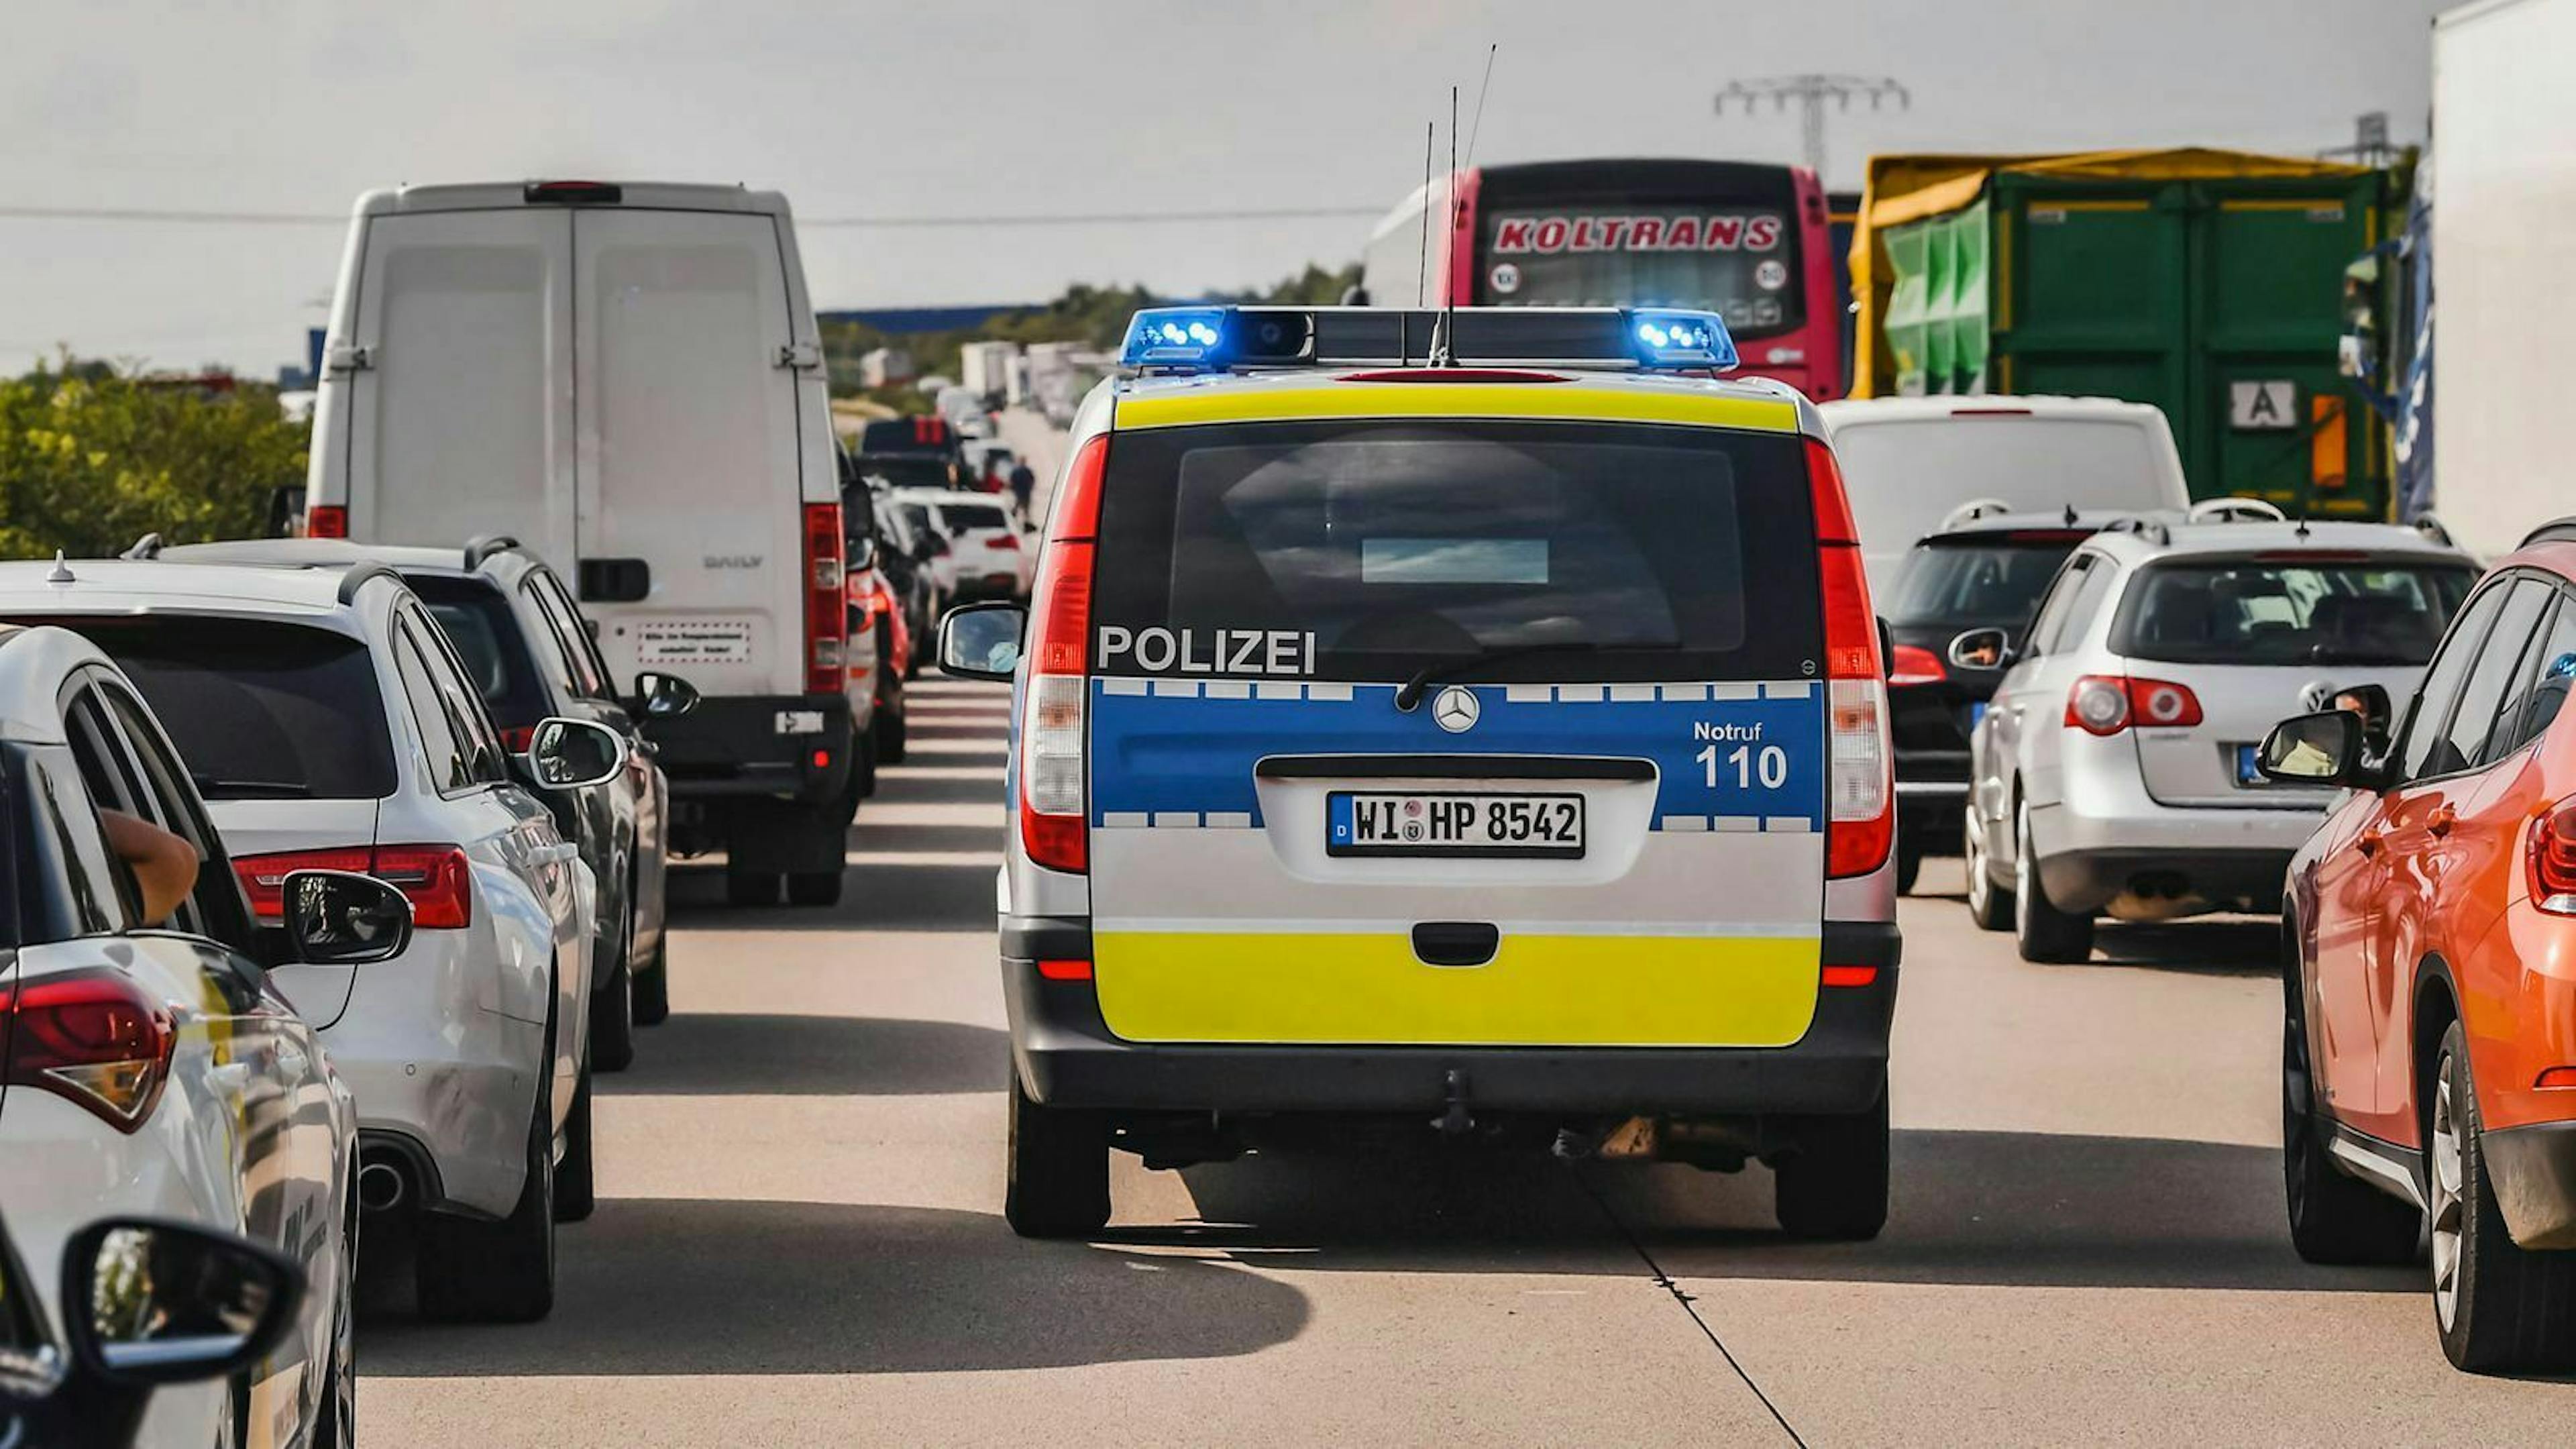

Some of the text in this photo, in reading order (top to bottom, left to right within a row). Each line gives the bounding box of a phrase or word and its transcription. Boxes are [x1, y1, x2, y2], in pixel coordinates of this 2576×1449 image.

[1493, 215, 1782, 252] KOLTRANS
[2250, 385, 2279, 421] A
[704, 555, 763, 568] DAILY
[1097, 625, 1316, 675] POLIZEI
[1694, 722, 1763, 741] Notruf
[1696, 745, 1787, 789] 110
[1356, 802, 1577, 841] WI HP 8542
